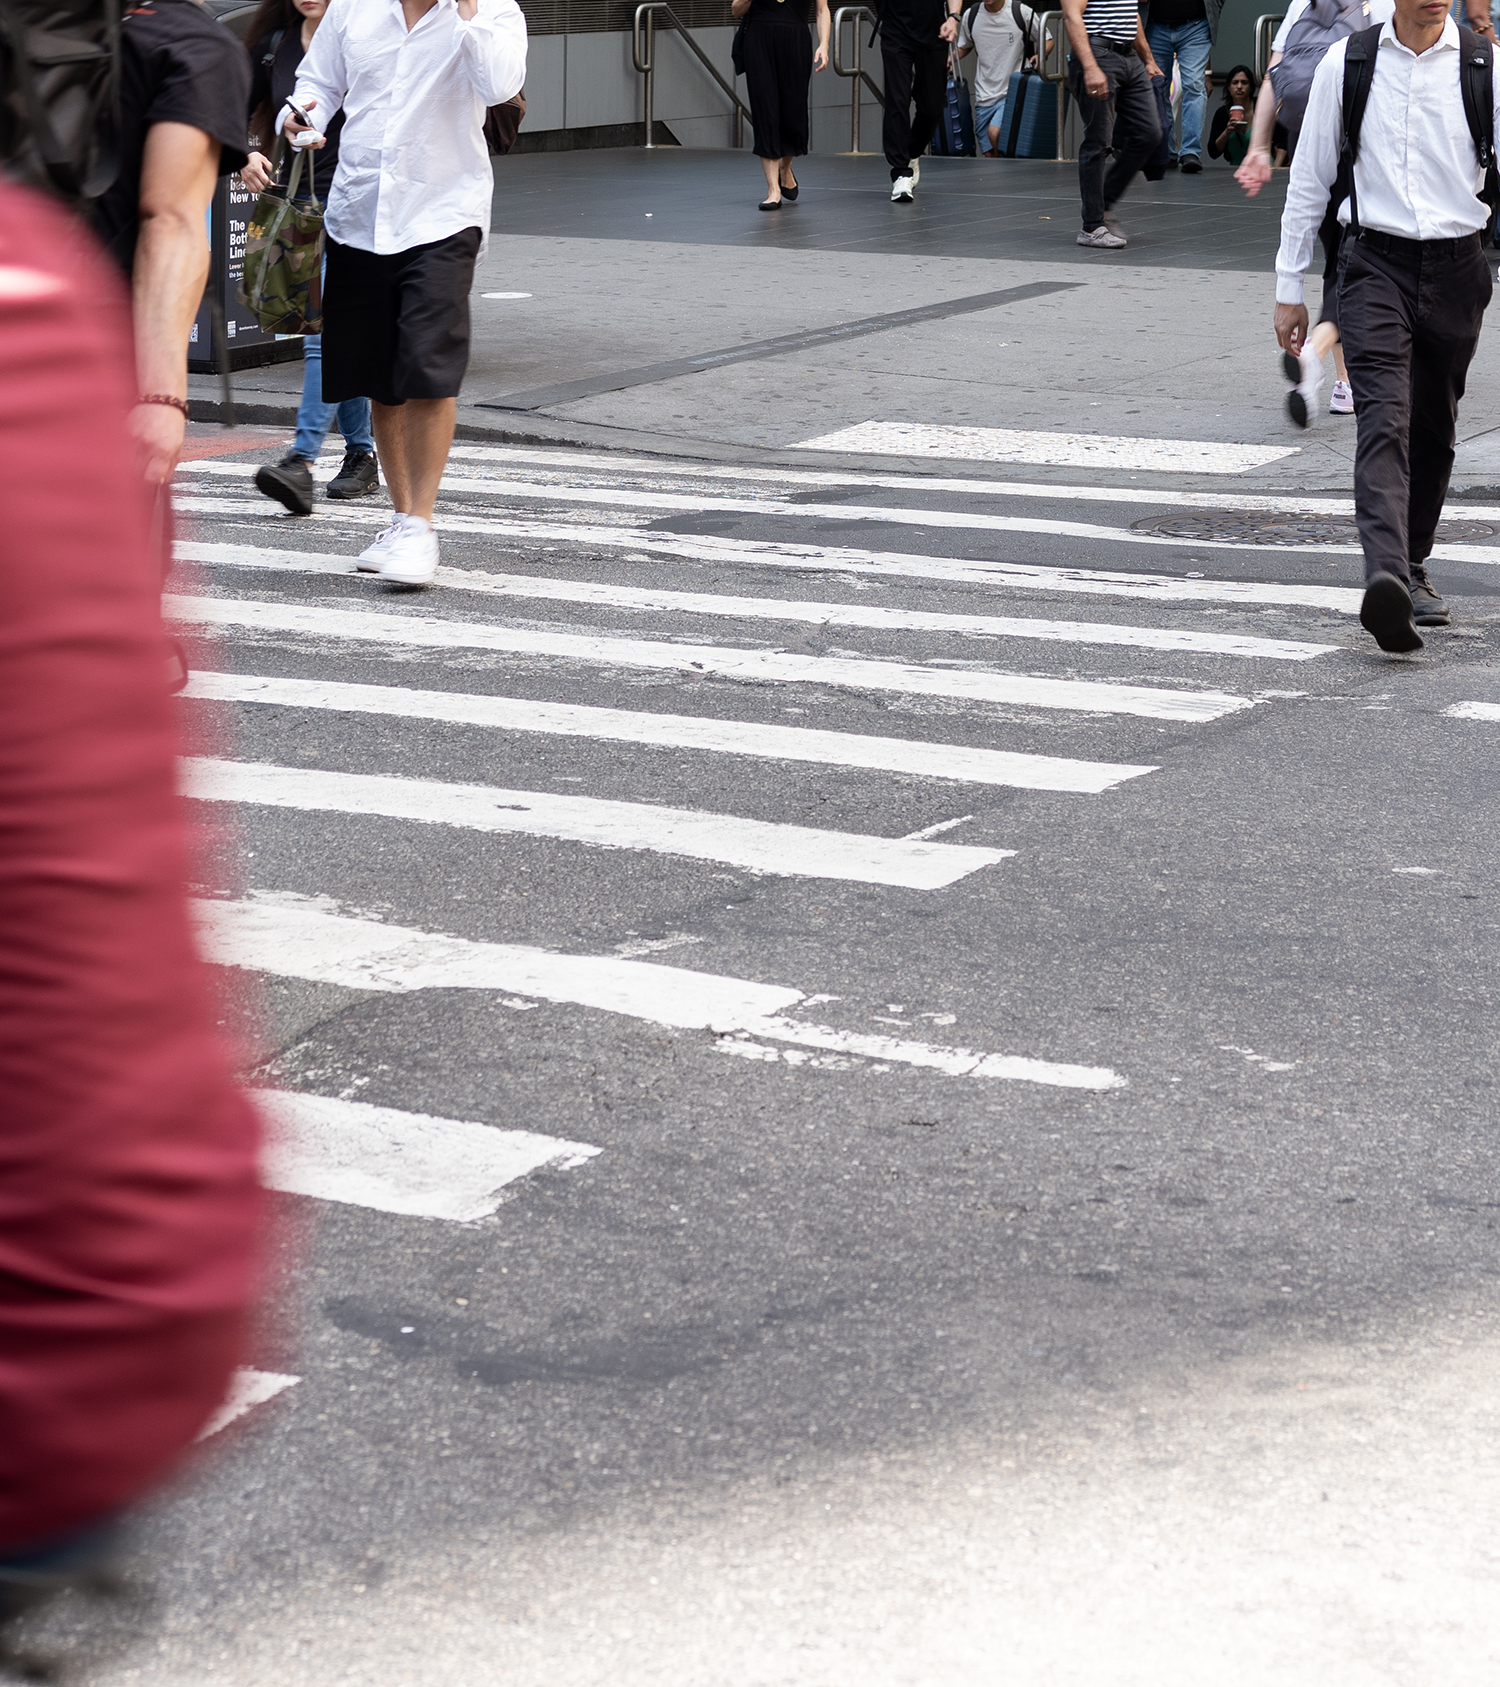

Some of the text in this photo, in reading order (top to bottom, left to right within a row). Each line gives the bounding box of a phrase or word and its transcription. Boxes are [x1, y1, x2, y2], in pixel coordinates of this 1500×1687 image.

[230, 192, 249, 204] New
[229, 220, 245, 232] The
[229, 233, 248, 246] Bott
